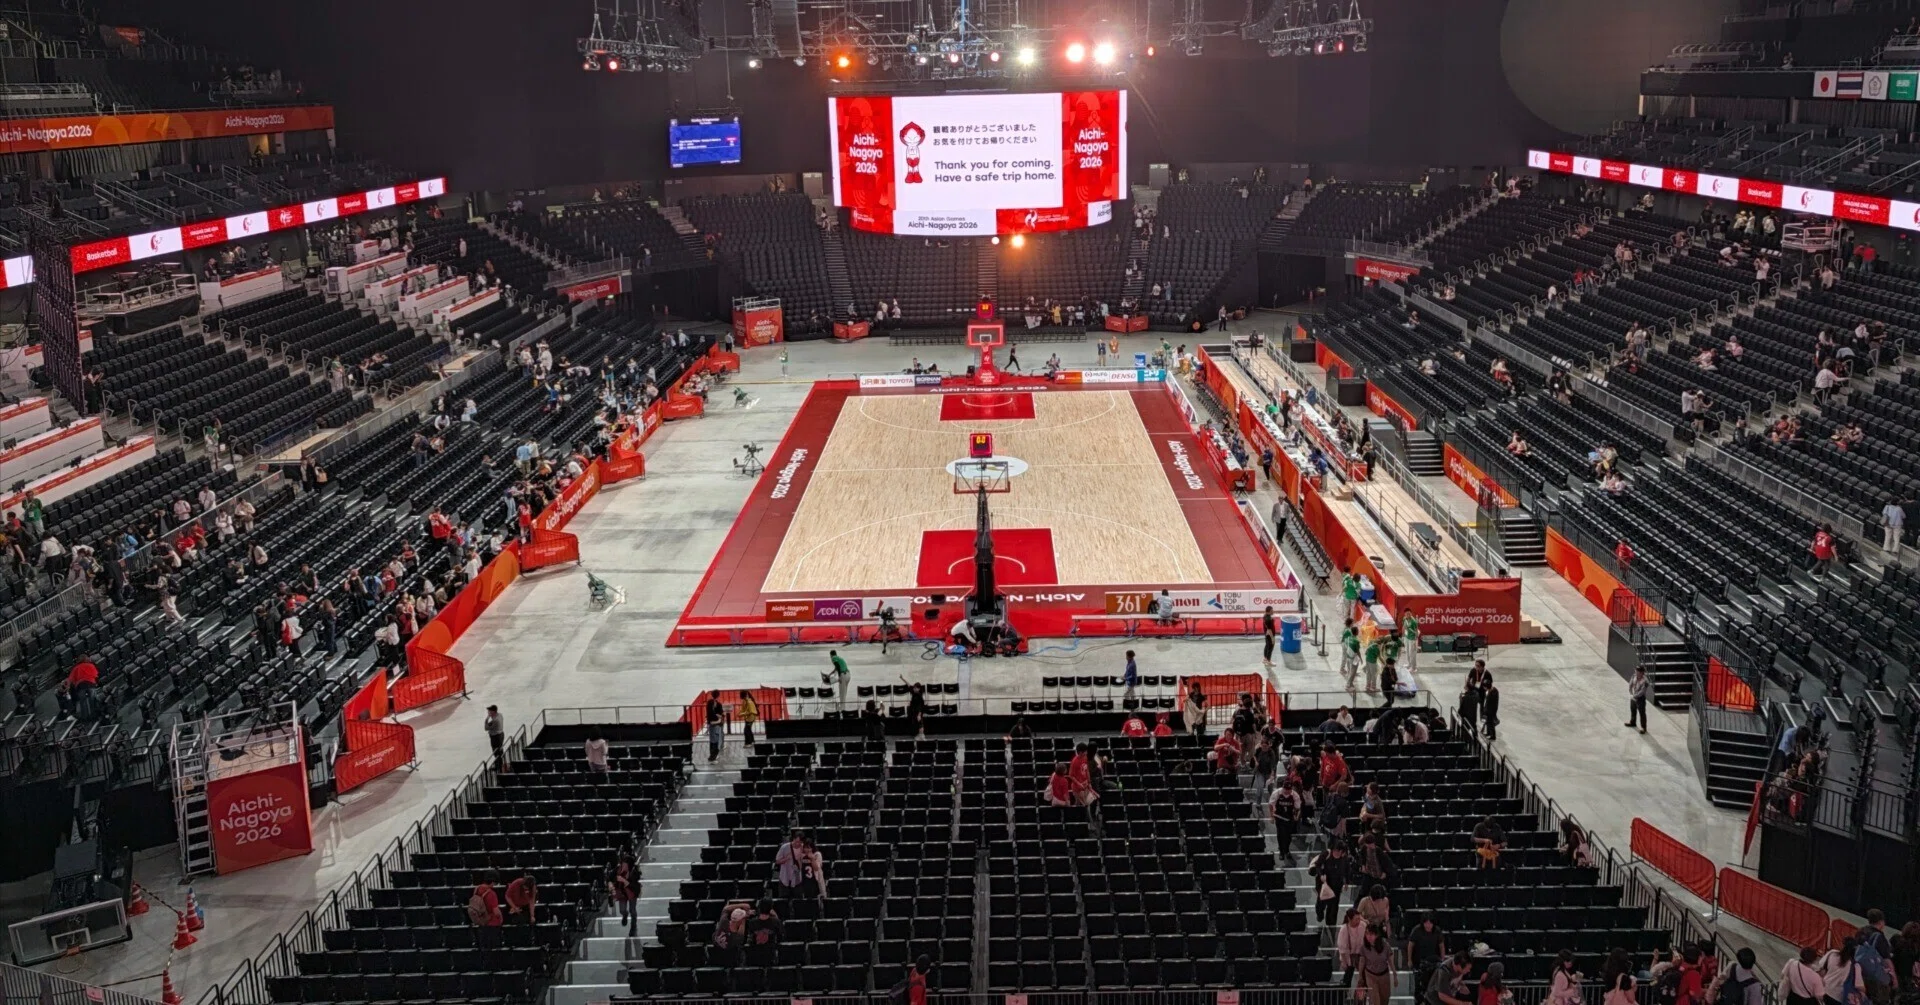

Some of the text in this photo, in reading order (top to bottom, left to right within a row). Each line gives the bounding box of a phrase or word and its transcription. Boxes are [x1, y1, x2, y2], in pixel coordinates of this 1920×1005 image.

[225, 116, 269, 128] Aichi-Nagoya
[0, 125, 92, 142] ichi-Nagoya 2026
[933, 124, 1036, 133] 観戦ありがとうございました
[1079, 128, 1106, 140] Aichi-
[853, 133, 879, 145] Aichi-
[933, 136, 1036, 146] お気を付けてお帰りください
[850, 146, 883, 161] Nagoya
[1074, 142, 1109, 156] Nagoya
[855, 162, 878, 174] 2026
[934, 158, 1054, 171] Thank you for coming.
[1080, 156, 1102, 168] 2026
[935, 174, 961, 182] Have
[975, 172, 998, 181] safe
[1002, 171, 1021, 182] trip
[1025, 172, 1056, 180] home.
[908, 221, 956, 230] Aichi-Nagoya
[86, 248, 118, 261] Basketball
[1116, 593, 1147, 612] 361°
[1171, 597, 1200, 607] anon
[1416, 614, 1513, 626] ichi-Nagoya 2026
[1130, 722, 1142, 730] 99
[228, 793, 282, 816] Aichi-
[220, 806, 292, 831] Nagoya
[235, 824, 281, 845] 2026
[805, 866, 812, 878] 3
